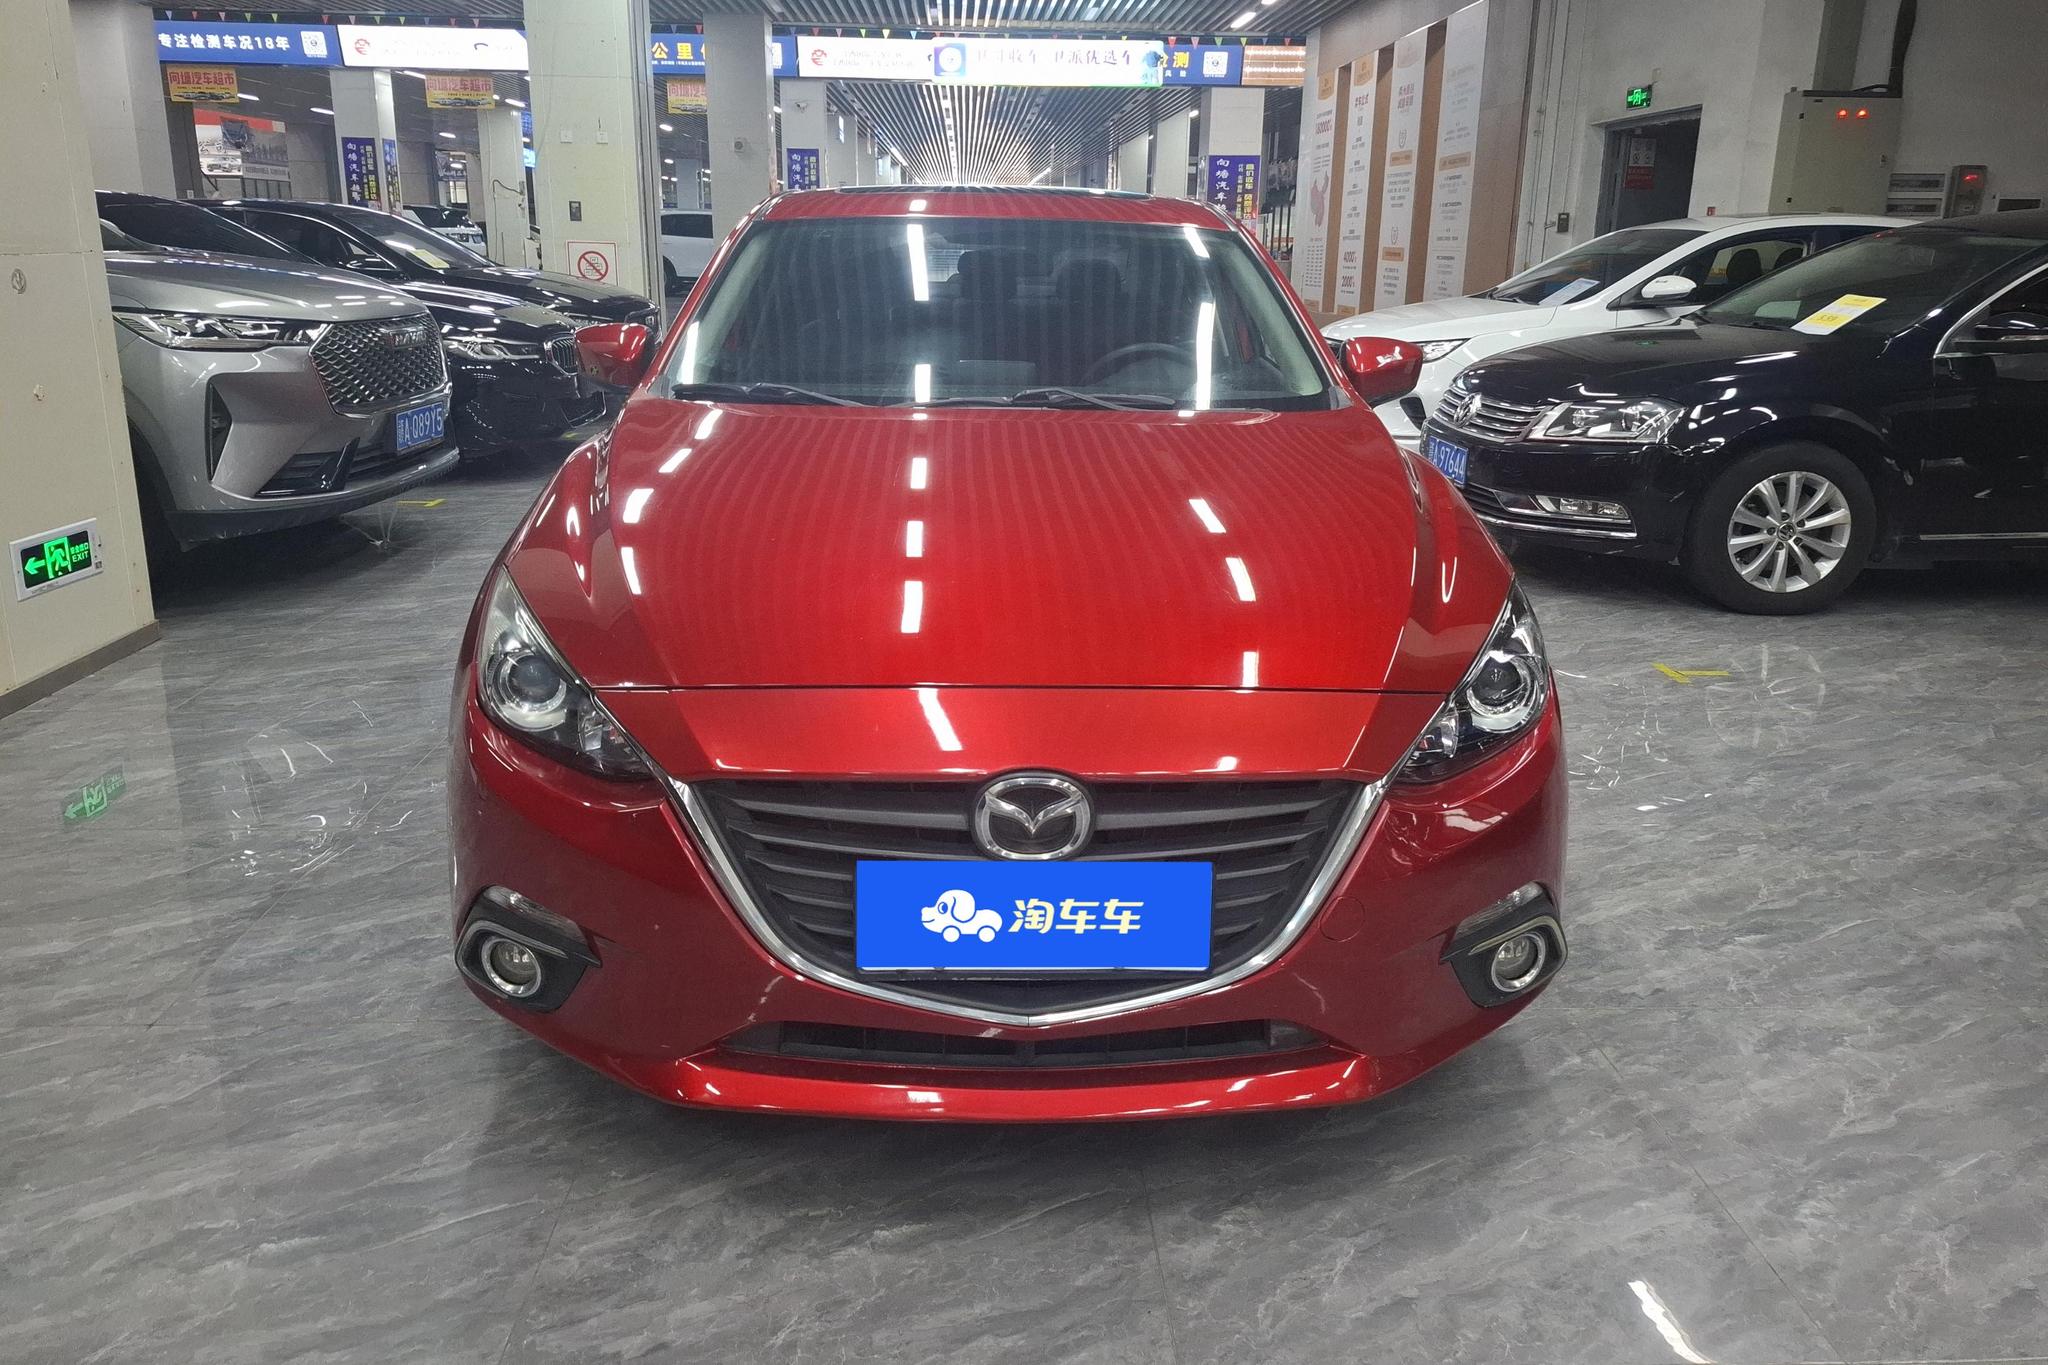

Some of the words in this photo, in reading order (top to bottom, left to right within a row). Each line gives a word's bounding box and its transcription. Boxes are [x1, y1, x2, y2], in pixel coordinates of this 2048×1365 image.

[158, 33, 290, 51] 专注检测车况18年
[651, 42, 706, 60] 公里
[169, 72, 234, 86] 向塘汽车超市
[72, 551, 88, 562] EXIT
